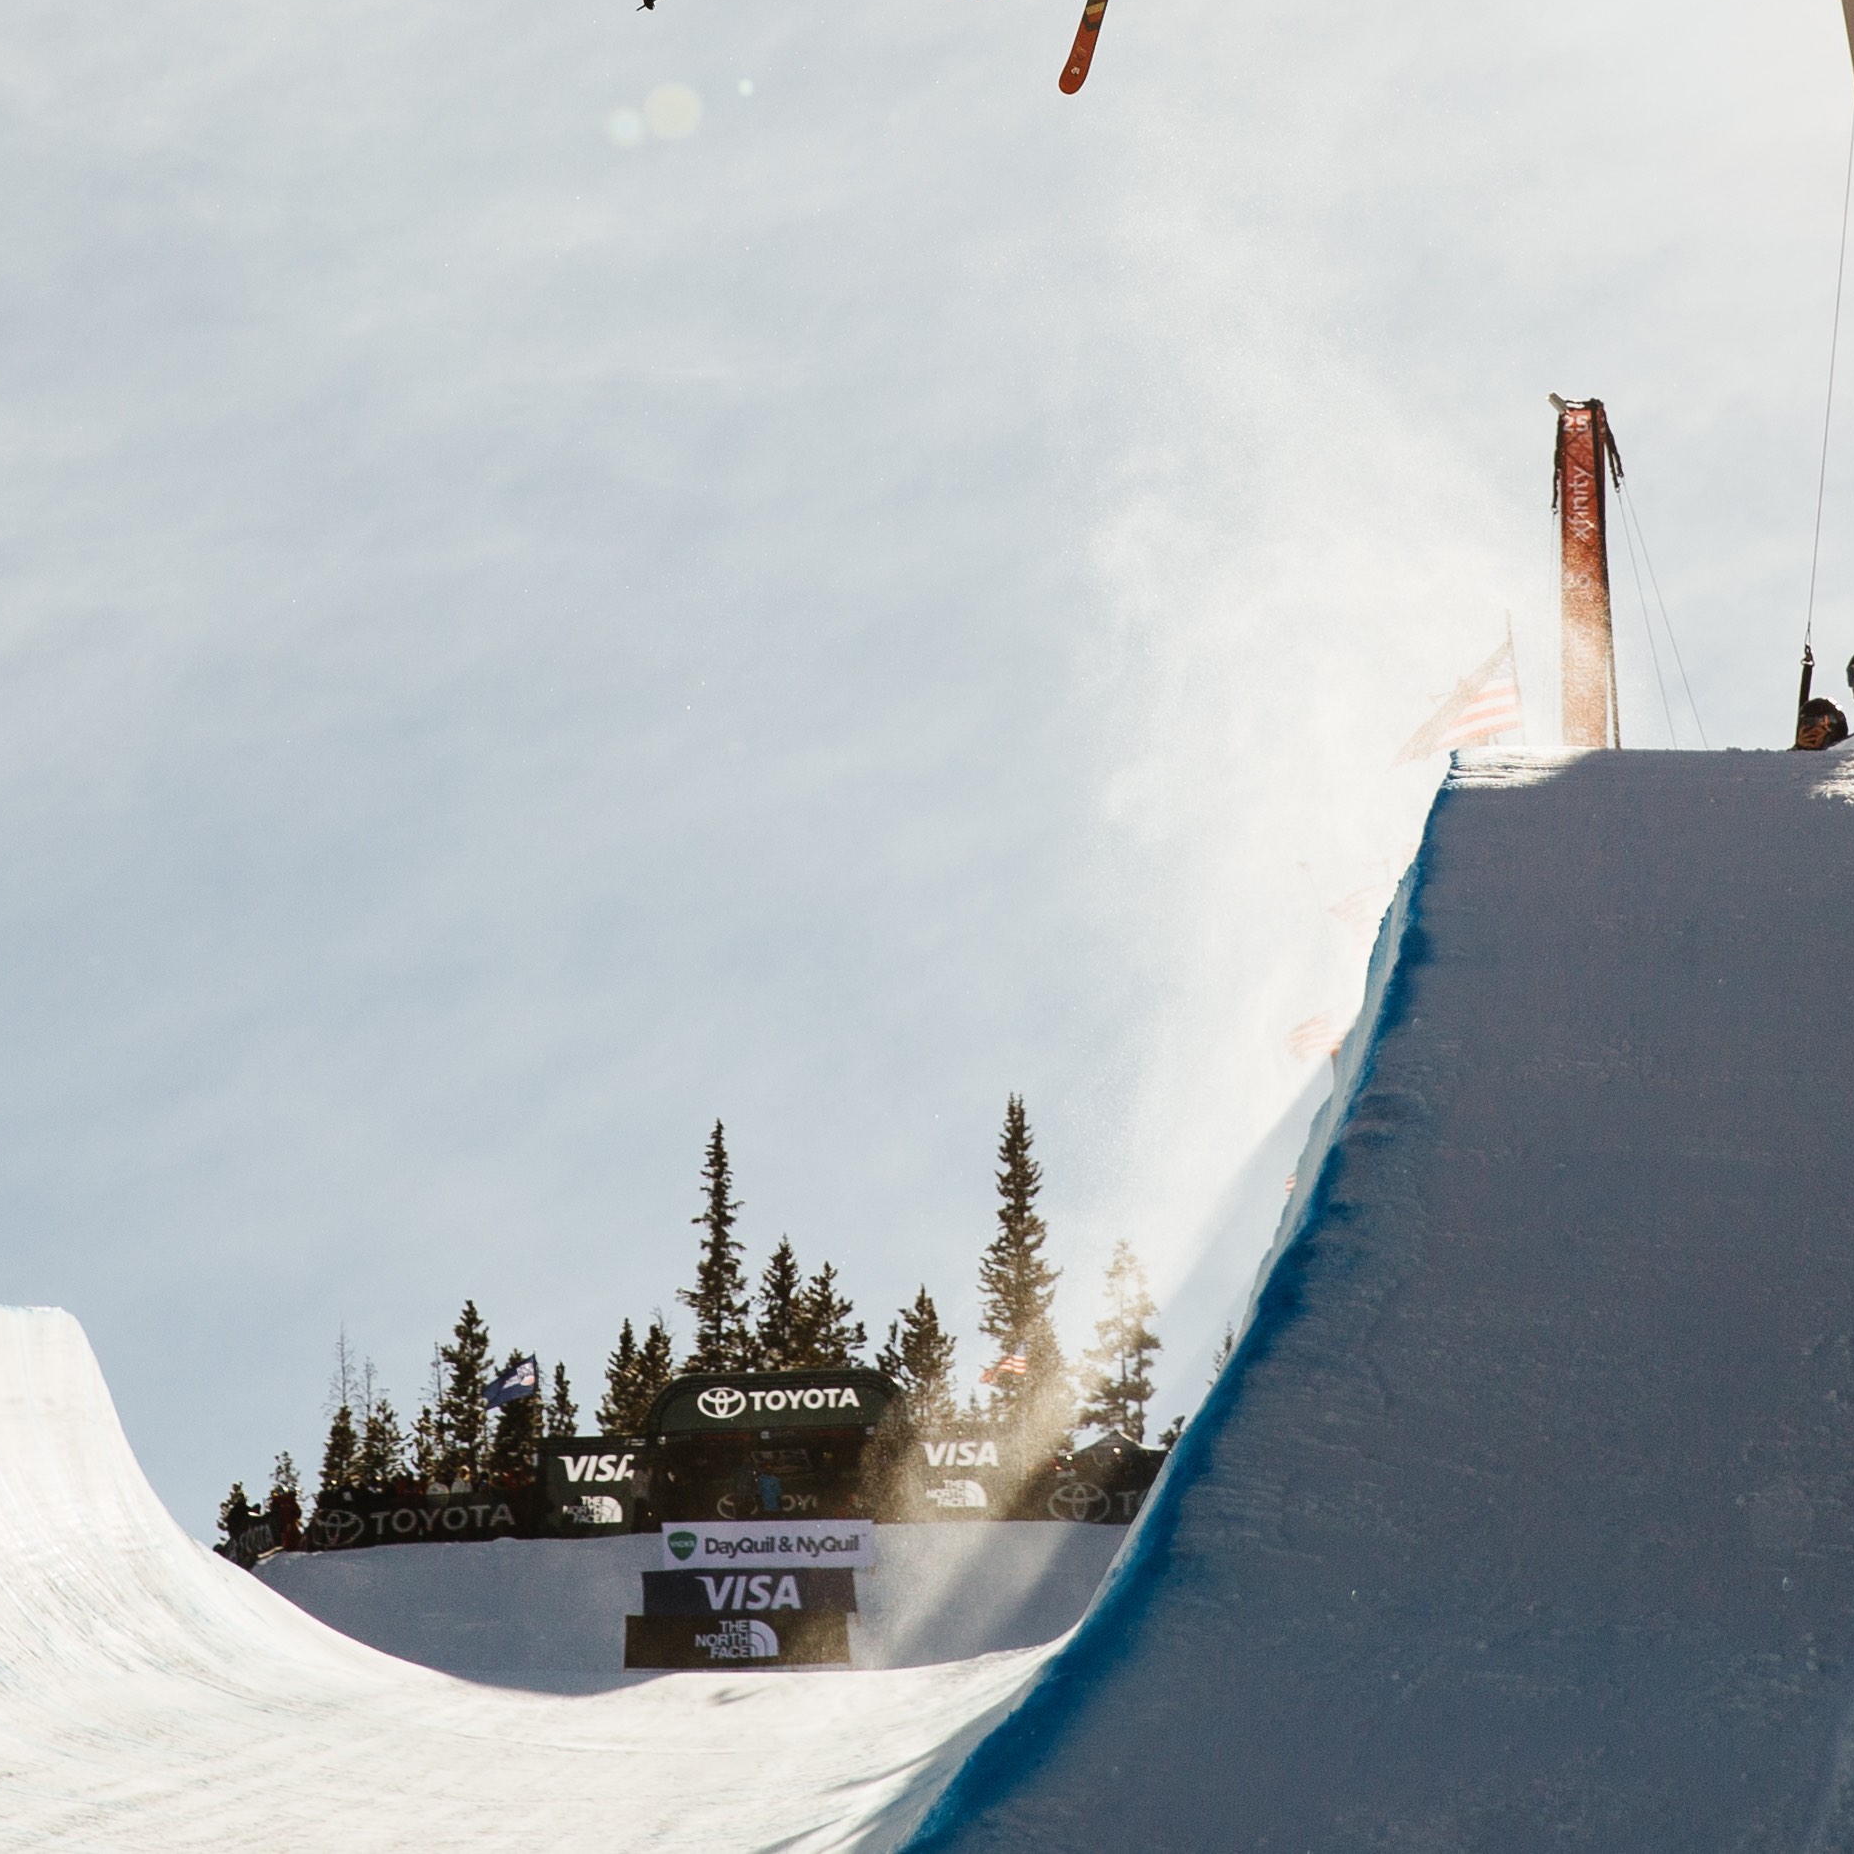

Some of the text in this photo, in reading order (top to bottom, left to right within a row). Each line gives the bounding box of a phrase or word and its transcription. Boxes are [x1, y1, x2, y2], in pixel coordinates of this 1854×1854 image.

[748, 1387, 861, 1411] TOYOTA
[920, 1440, 1000, 1467] VISA
[369, 1502, 516, 1535] TOYOTA
[704, 1534, 860, 1559] DayQuil & NyQuil
[694, 1575, 803, 1611] VISA
[719, 1620, 750, 1632] THE
[695, 1632, 750, 1647] NORTH
[710, 1646, 750, 1659] FACE
